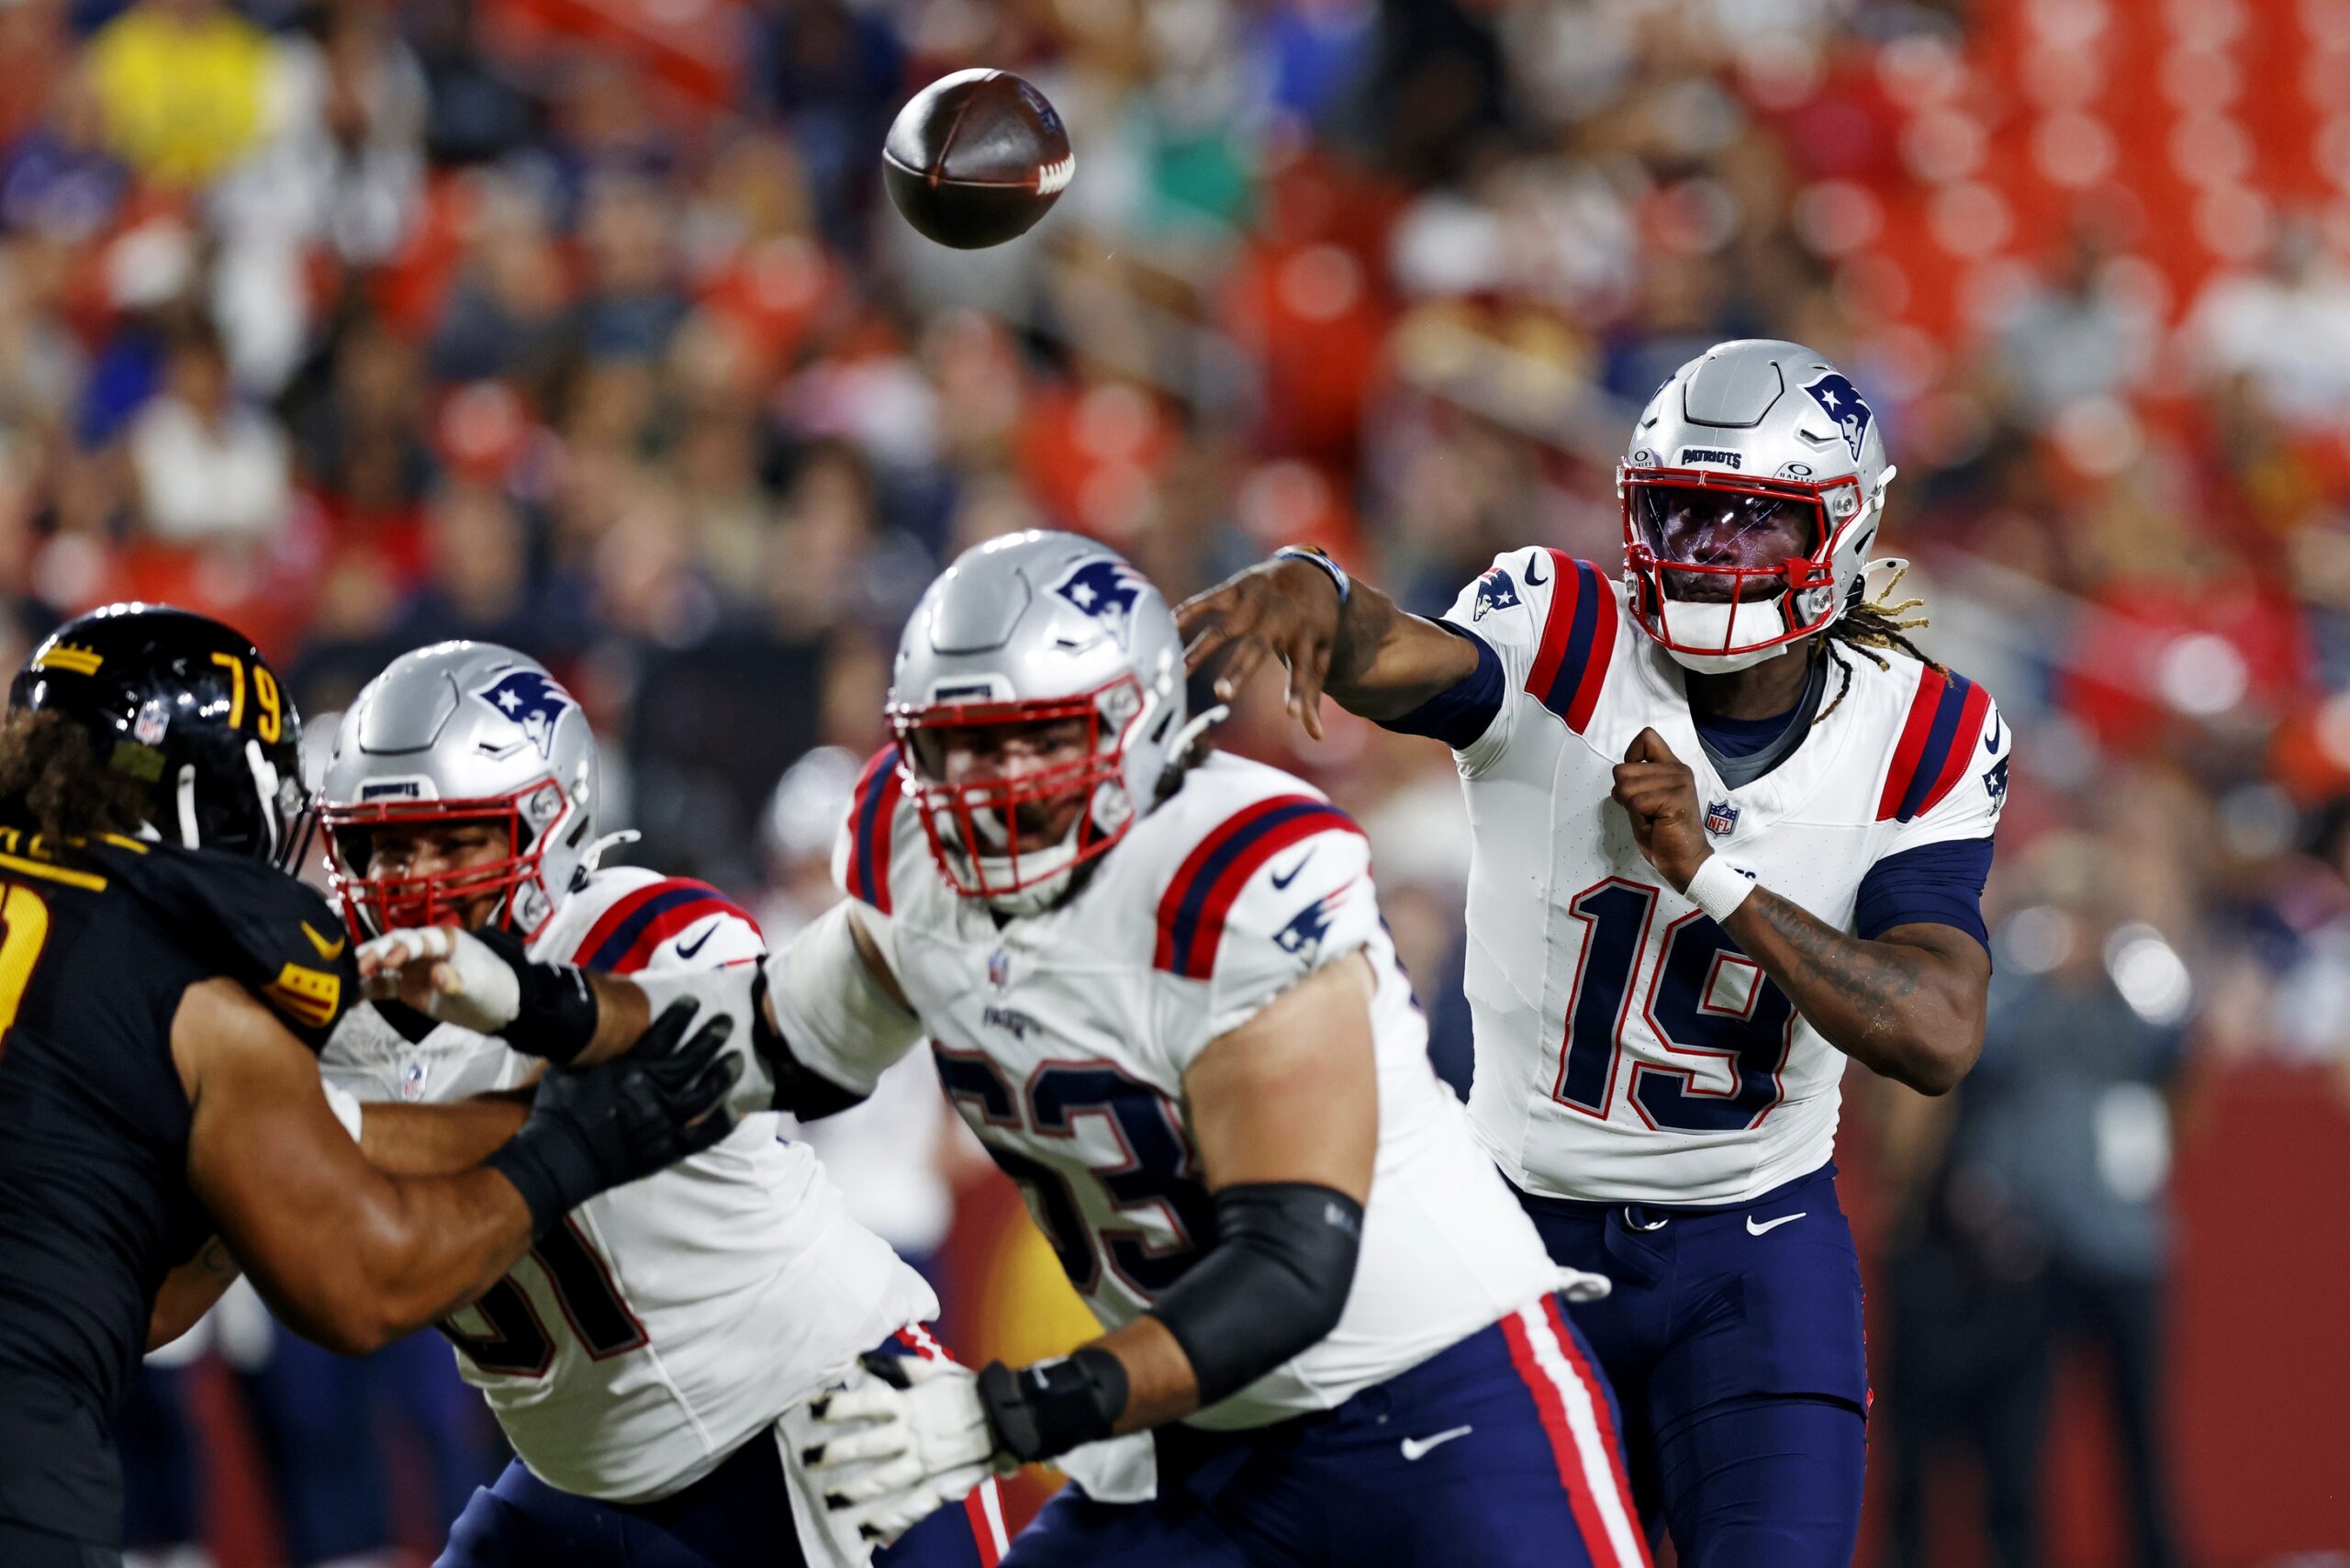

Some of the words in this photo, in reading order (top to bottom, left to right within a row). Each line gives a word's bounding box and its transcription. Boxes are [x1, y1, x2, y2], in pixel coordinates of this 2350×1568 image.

[1682, 449, 1742, 470] PATRIOTS
[210, 651, 281, 745] 79
[1707, 814, 1730, 833] NFL
[1553, 876, 1799, 1134] 19
[932, 1038, 1219, 1304] 63
